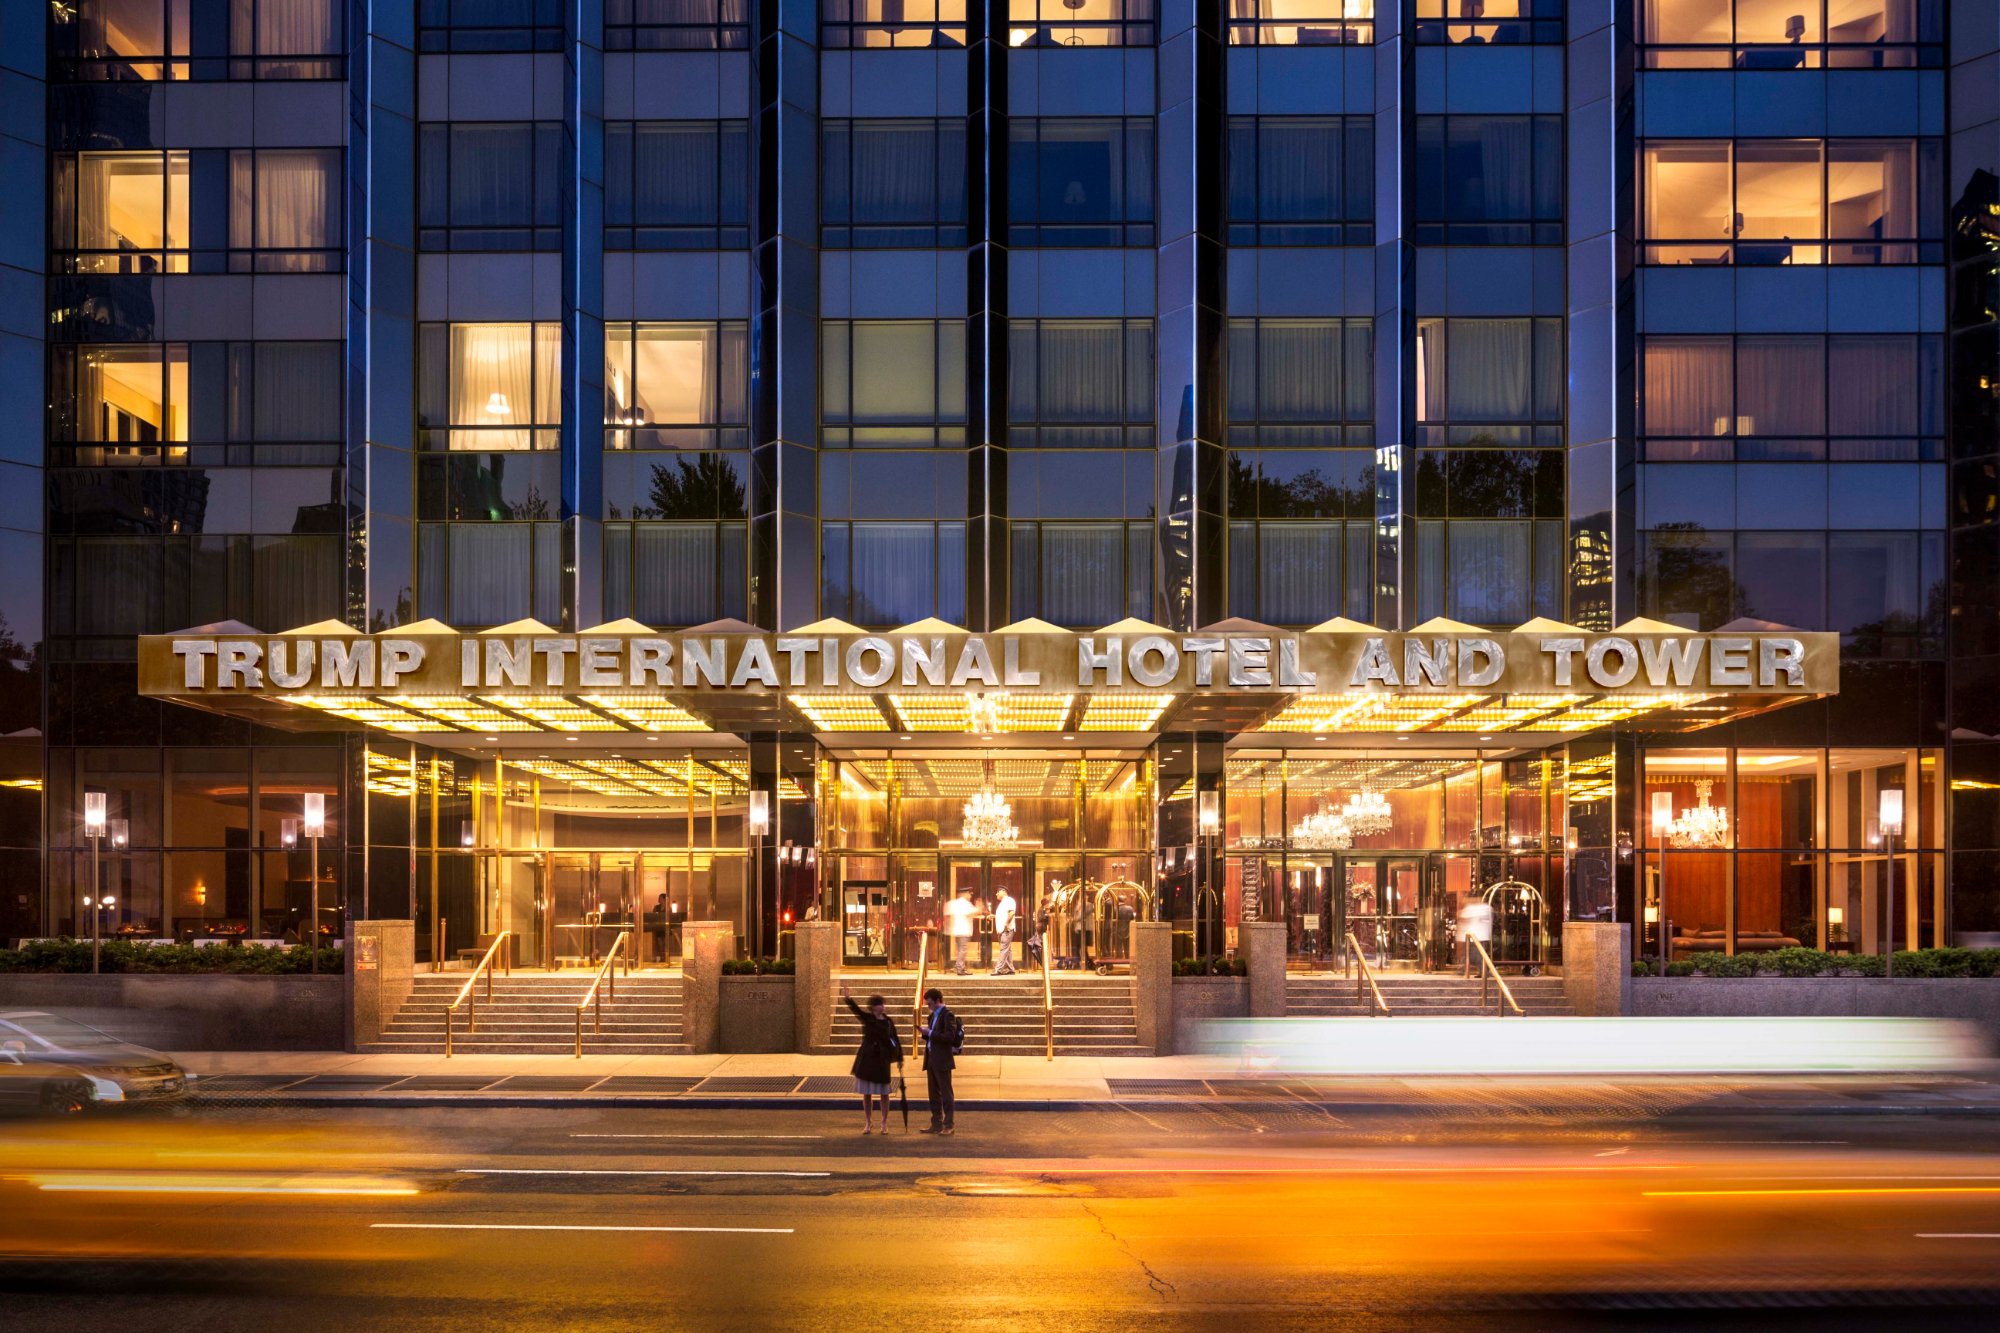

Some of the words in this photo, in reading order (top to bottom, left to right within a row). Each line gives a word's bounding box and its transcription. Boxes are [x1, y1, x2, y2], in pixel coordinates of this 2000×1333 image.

[173, 639, 425, 688] TRUMP
[461, 637, 1041, 687] INTERNATIONAL
[1078, 636, 1317, 687] HOTEL
[1350, 637, 1505, 687] AND
[1540, 637, 1806, 687] TOWER
[748, 991, 768, 999] ONE
[1200, 991, 1220, 1000] ONE
[1656, 993, 1675, 1001] ONE
